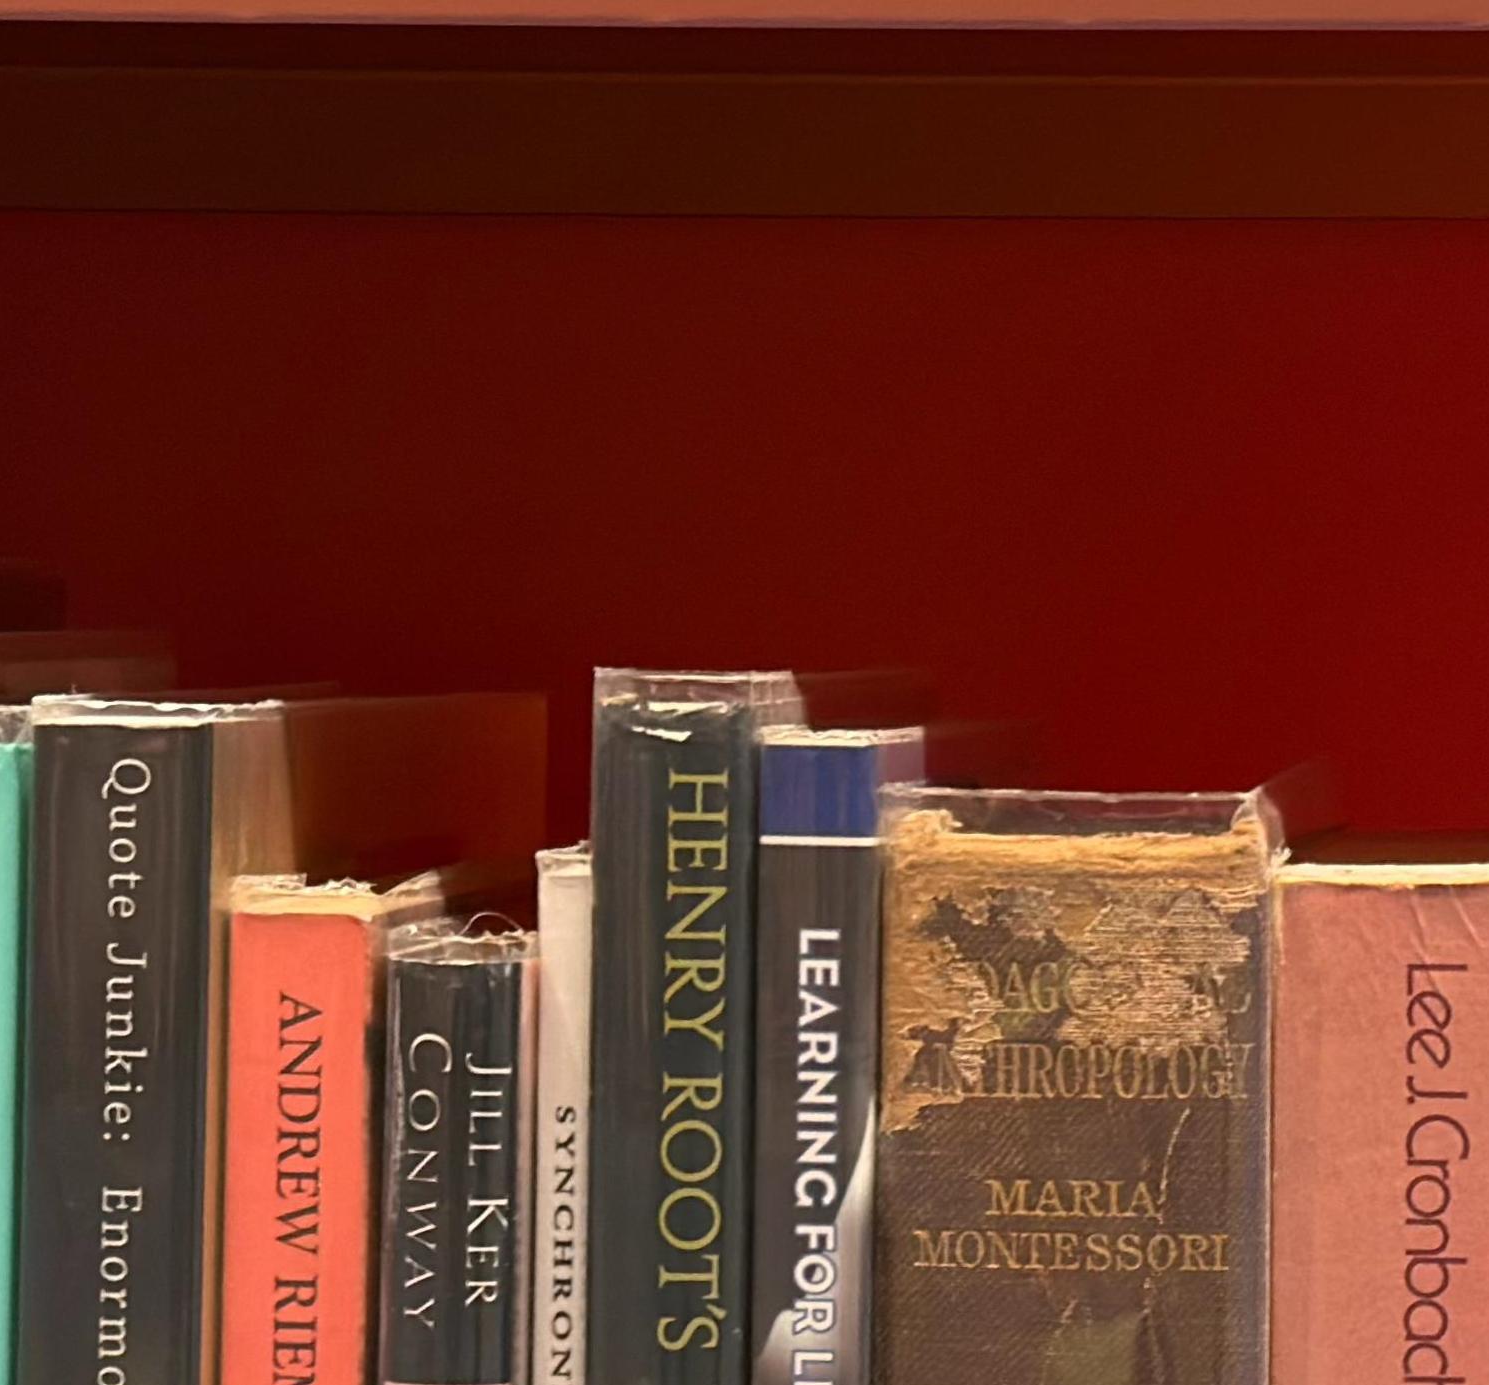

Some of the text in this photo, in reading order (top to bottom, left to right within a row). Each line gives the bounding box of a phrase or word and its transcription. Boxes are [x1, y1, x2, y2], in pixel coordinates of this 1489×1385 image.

[101, 758, 151, 920] Quote
[663, 768, 729, 1052] HENRY
[102, 943, 148, 1142] Junkie:
[794, 929, 841, 1208] LEARNING
[1404, 963, 1469, 1070] Lee
[1404, 1075, 1469, 1104] J.
[274, 992, 324, 1254] ANDREW
[403, 1033, 453, 1330] CONWAY
[465, 1052, 513, 1308] JILL KER
[656, 1073, 724, 1351] ROOT'S
[984, 1180, 1163, 1217] MARIA
[792, 1225, 837, 1334] FOR
[913, 1231, 1230, 1272] MONTESSORI
